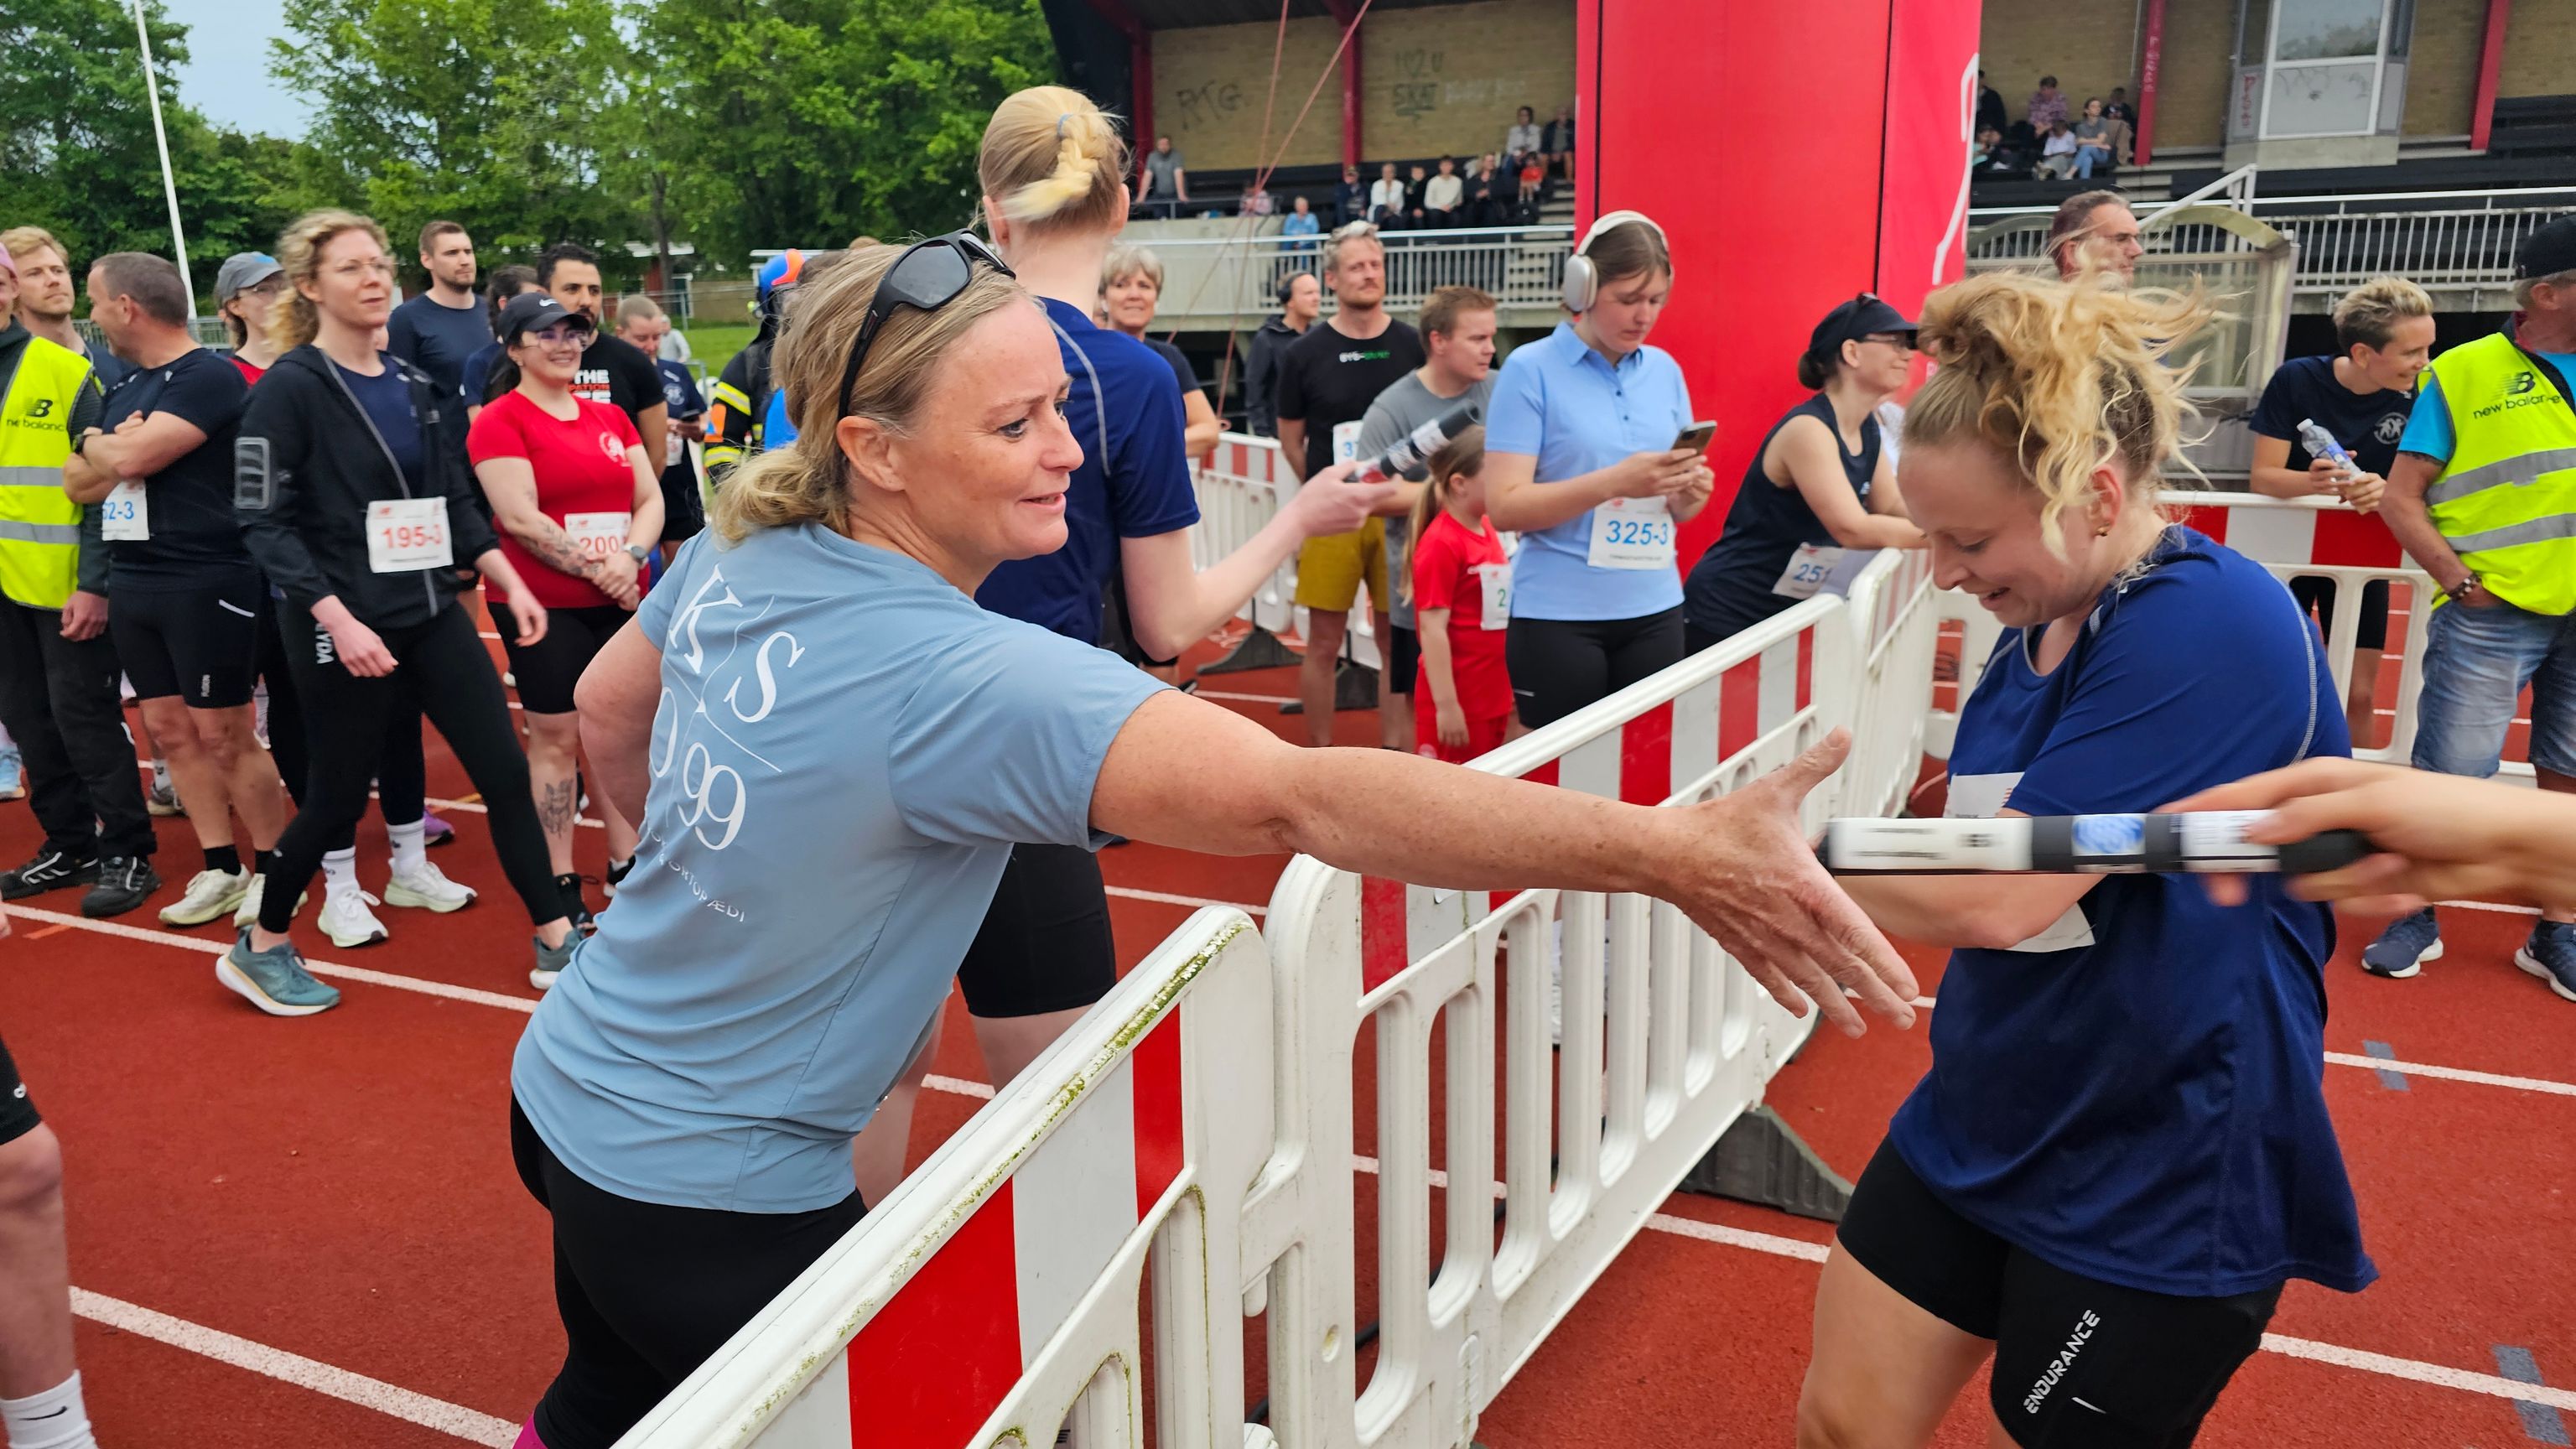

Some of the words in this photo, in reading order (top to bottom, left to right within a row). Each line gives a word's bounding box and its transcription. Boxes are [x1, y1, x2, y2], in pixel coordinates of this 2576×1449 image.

[574, 369, 610, 384] THE
[2473, 404, 2502, 418] new
[23, 418, 65, 432] balanc
[382, 524, 443, 549] 195-3
[579, 535, 629, 554] 200
[1606, 520, 1669, 545] 325-3
[1793, 564, 1832, 584] 25
[668, 563, 743, 674] K
[723, 631, 805, 723] S
[677, 741, 746, 850] 99
[667, 860, 745, 922] ORTOPÆDI
[2023, 1309, 2101, 1414] ENDURANCE
